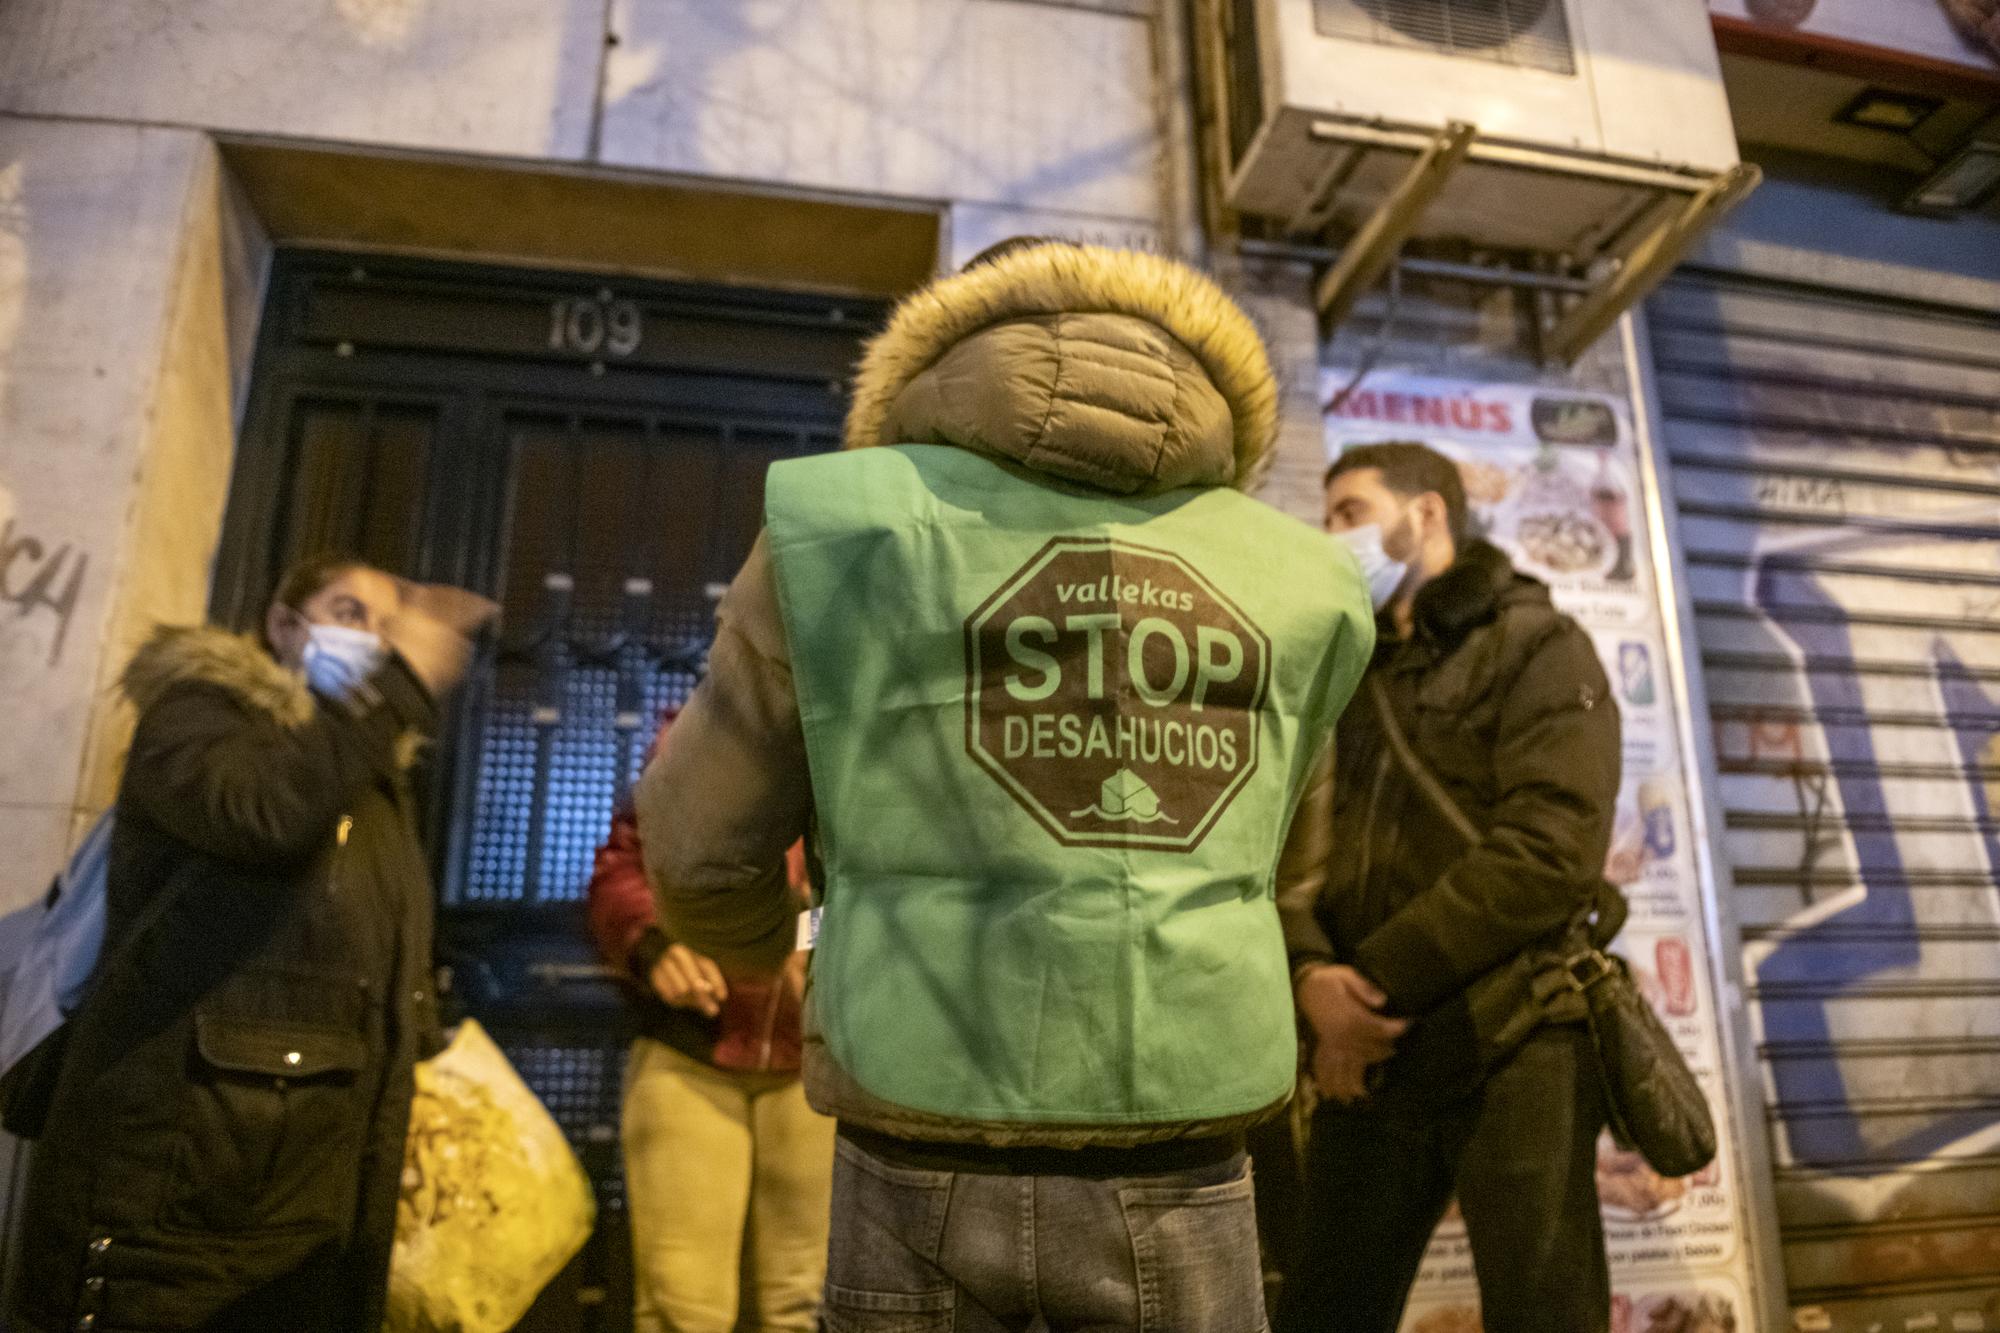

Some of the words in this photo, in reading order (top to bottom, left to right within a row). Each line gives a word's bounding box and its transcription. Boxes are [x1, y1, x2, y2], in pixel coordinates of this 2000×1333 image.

[549, 300, 642, 357] 109
[1056, 575, 1194, 612] vallekas
[1004, 613, 1244, 712] STOP
[1004, 713, 1238, 772] DESAHUCIOS
